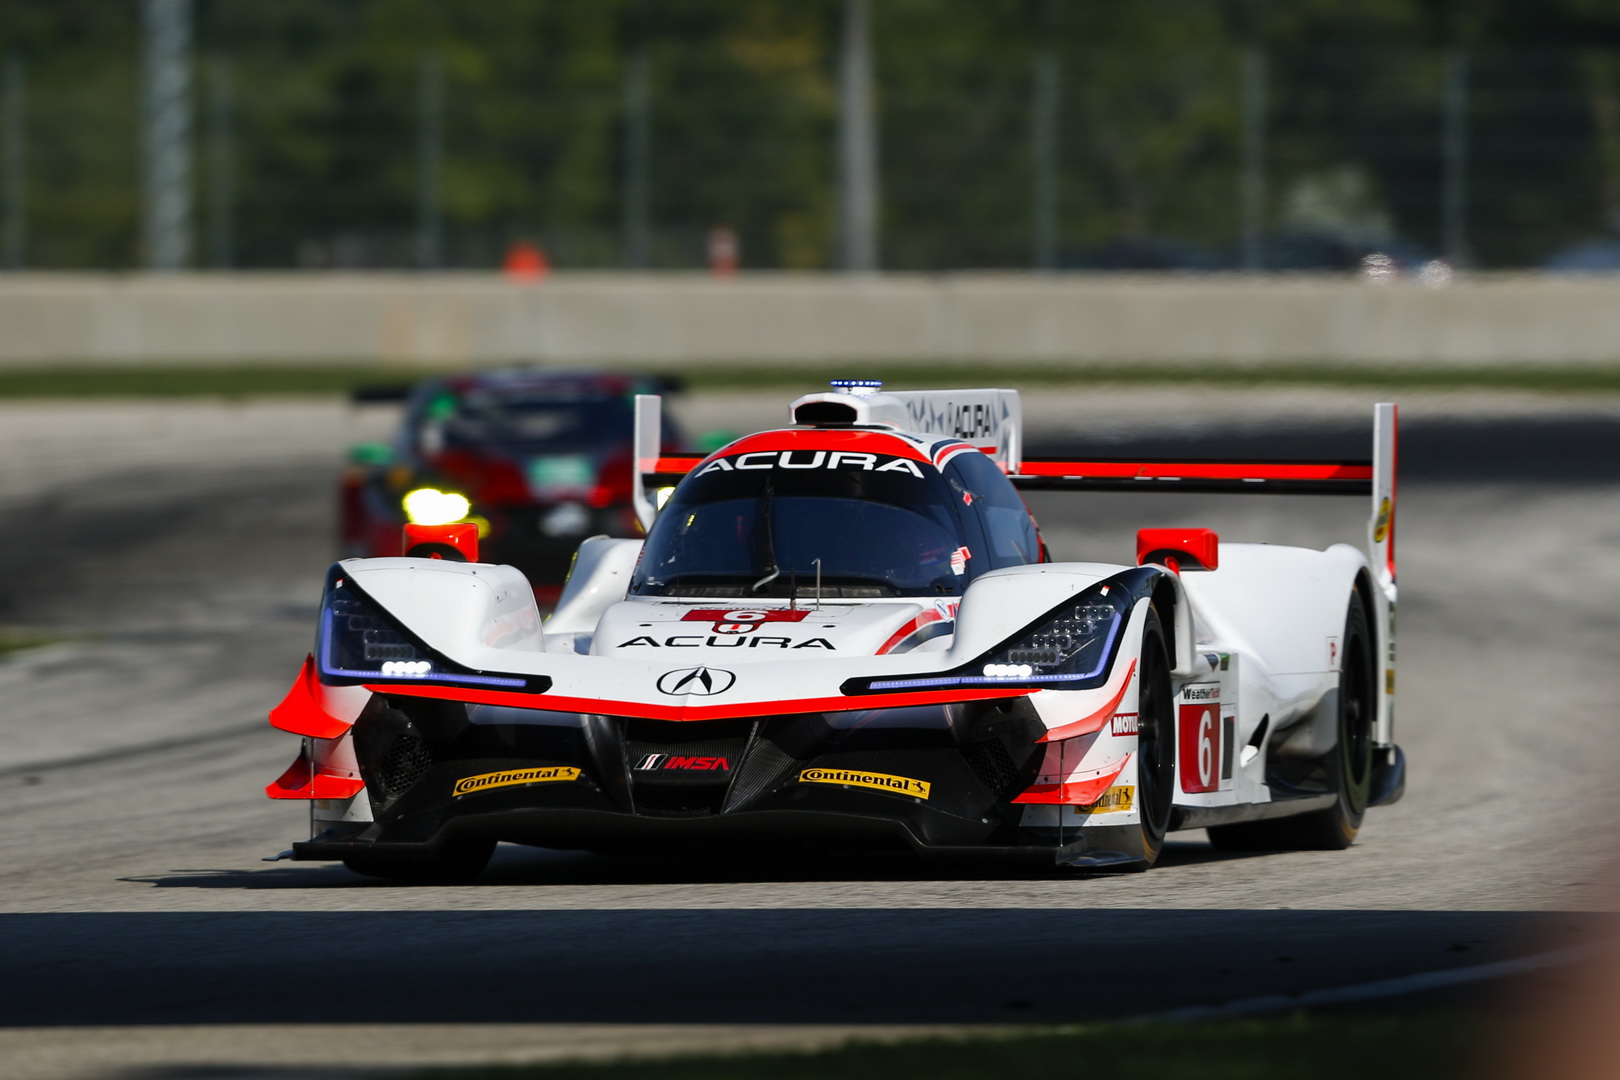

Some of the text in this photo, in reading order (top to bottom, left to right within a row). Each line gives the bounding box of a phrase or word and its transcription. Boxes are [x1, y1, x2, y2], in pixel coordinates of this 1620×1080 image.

[953, 404, 993, 439] ACURA
[695, 451, 925, 479] ACURA
[723, 610, 769, 621] 6
[616, 636, 837, 650] ACURA
[1198, 709, 1212, 787] 6
[664, 756, 729, 770] IMSA
[456, 768, 560, 792] Continental
[801, 768, 910, 791] Continental
